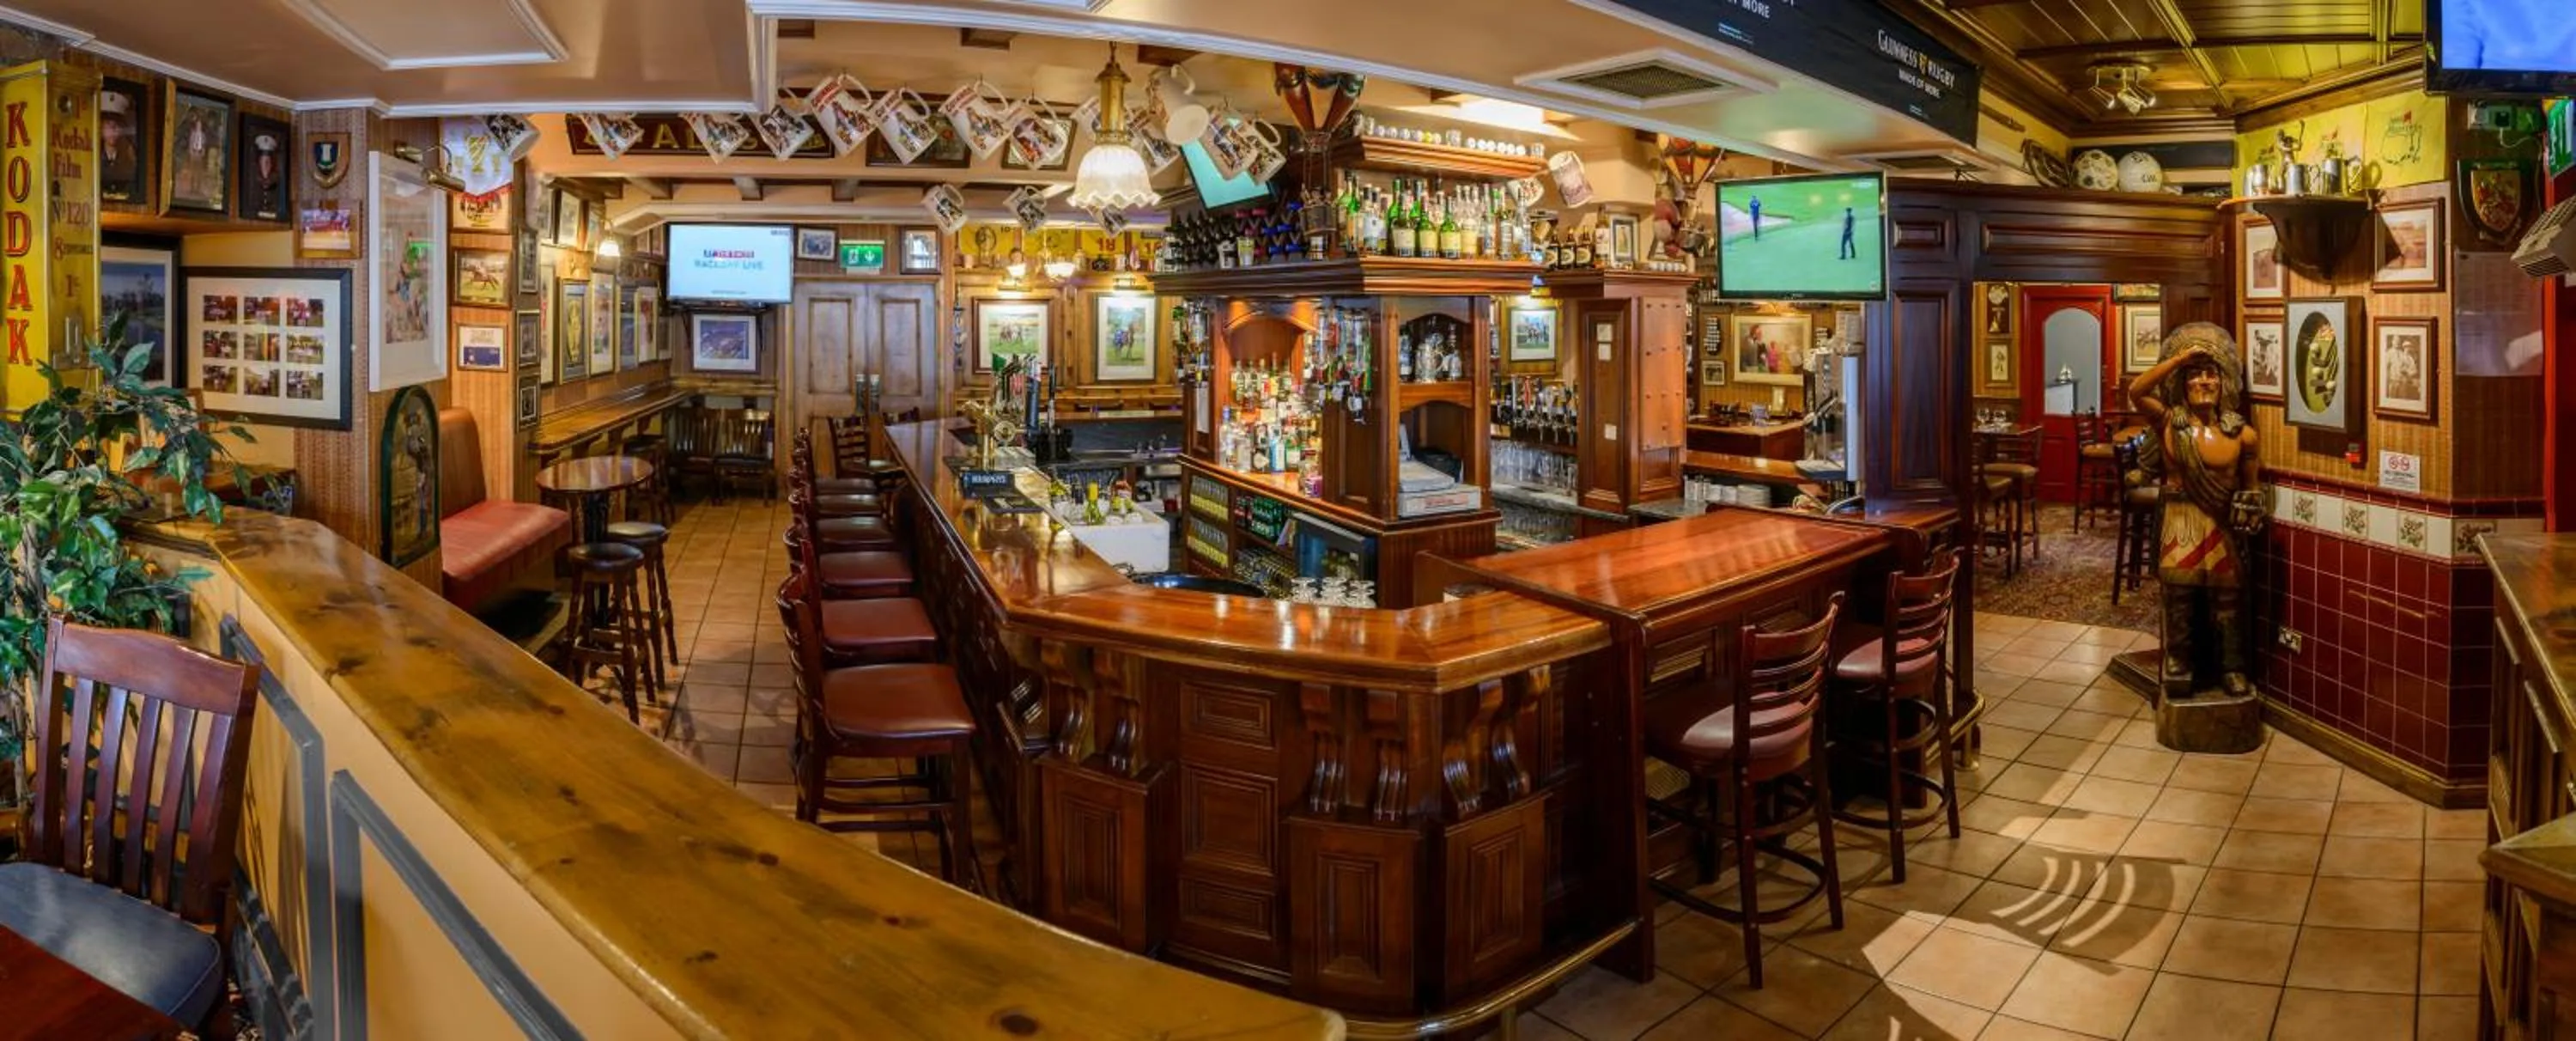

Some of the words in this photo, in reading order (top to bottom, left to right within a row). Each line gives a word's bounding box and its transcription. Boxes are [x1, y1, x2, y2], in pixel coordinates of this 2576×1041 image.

[1741, 0, 1770, 18] MORE
[1878, 28, 1917, 68] GUINNESS
[1928, 59, 1955, 89] RUGBY
[53, 152, 82, 180] Film
[5, 101, 33, 366] KODAK
[1096, 237, 1115, 252] 18
